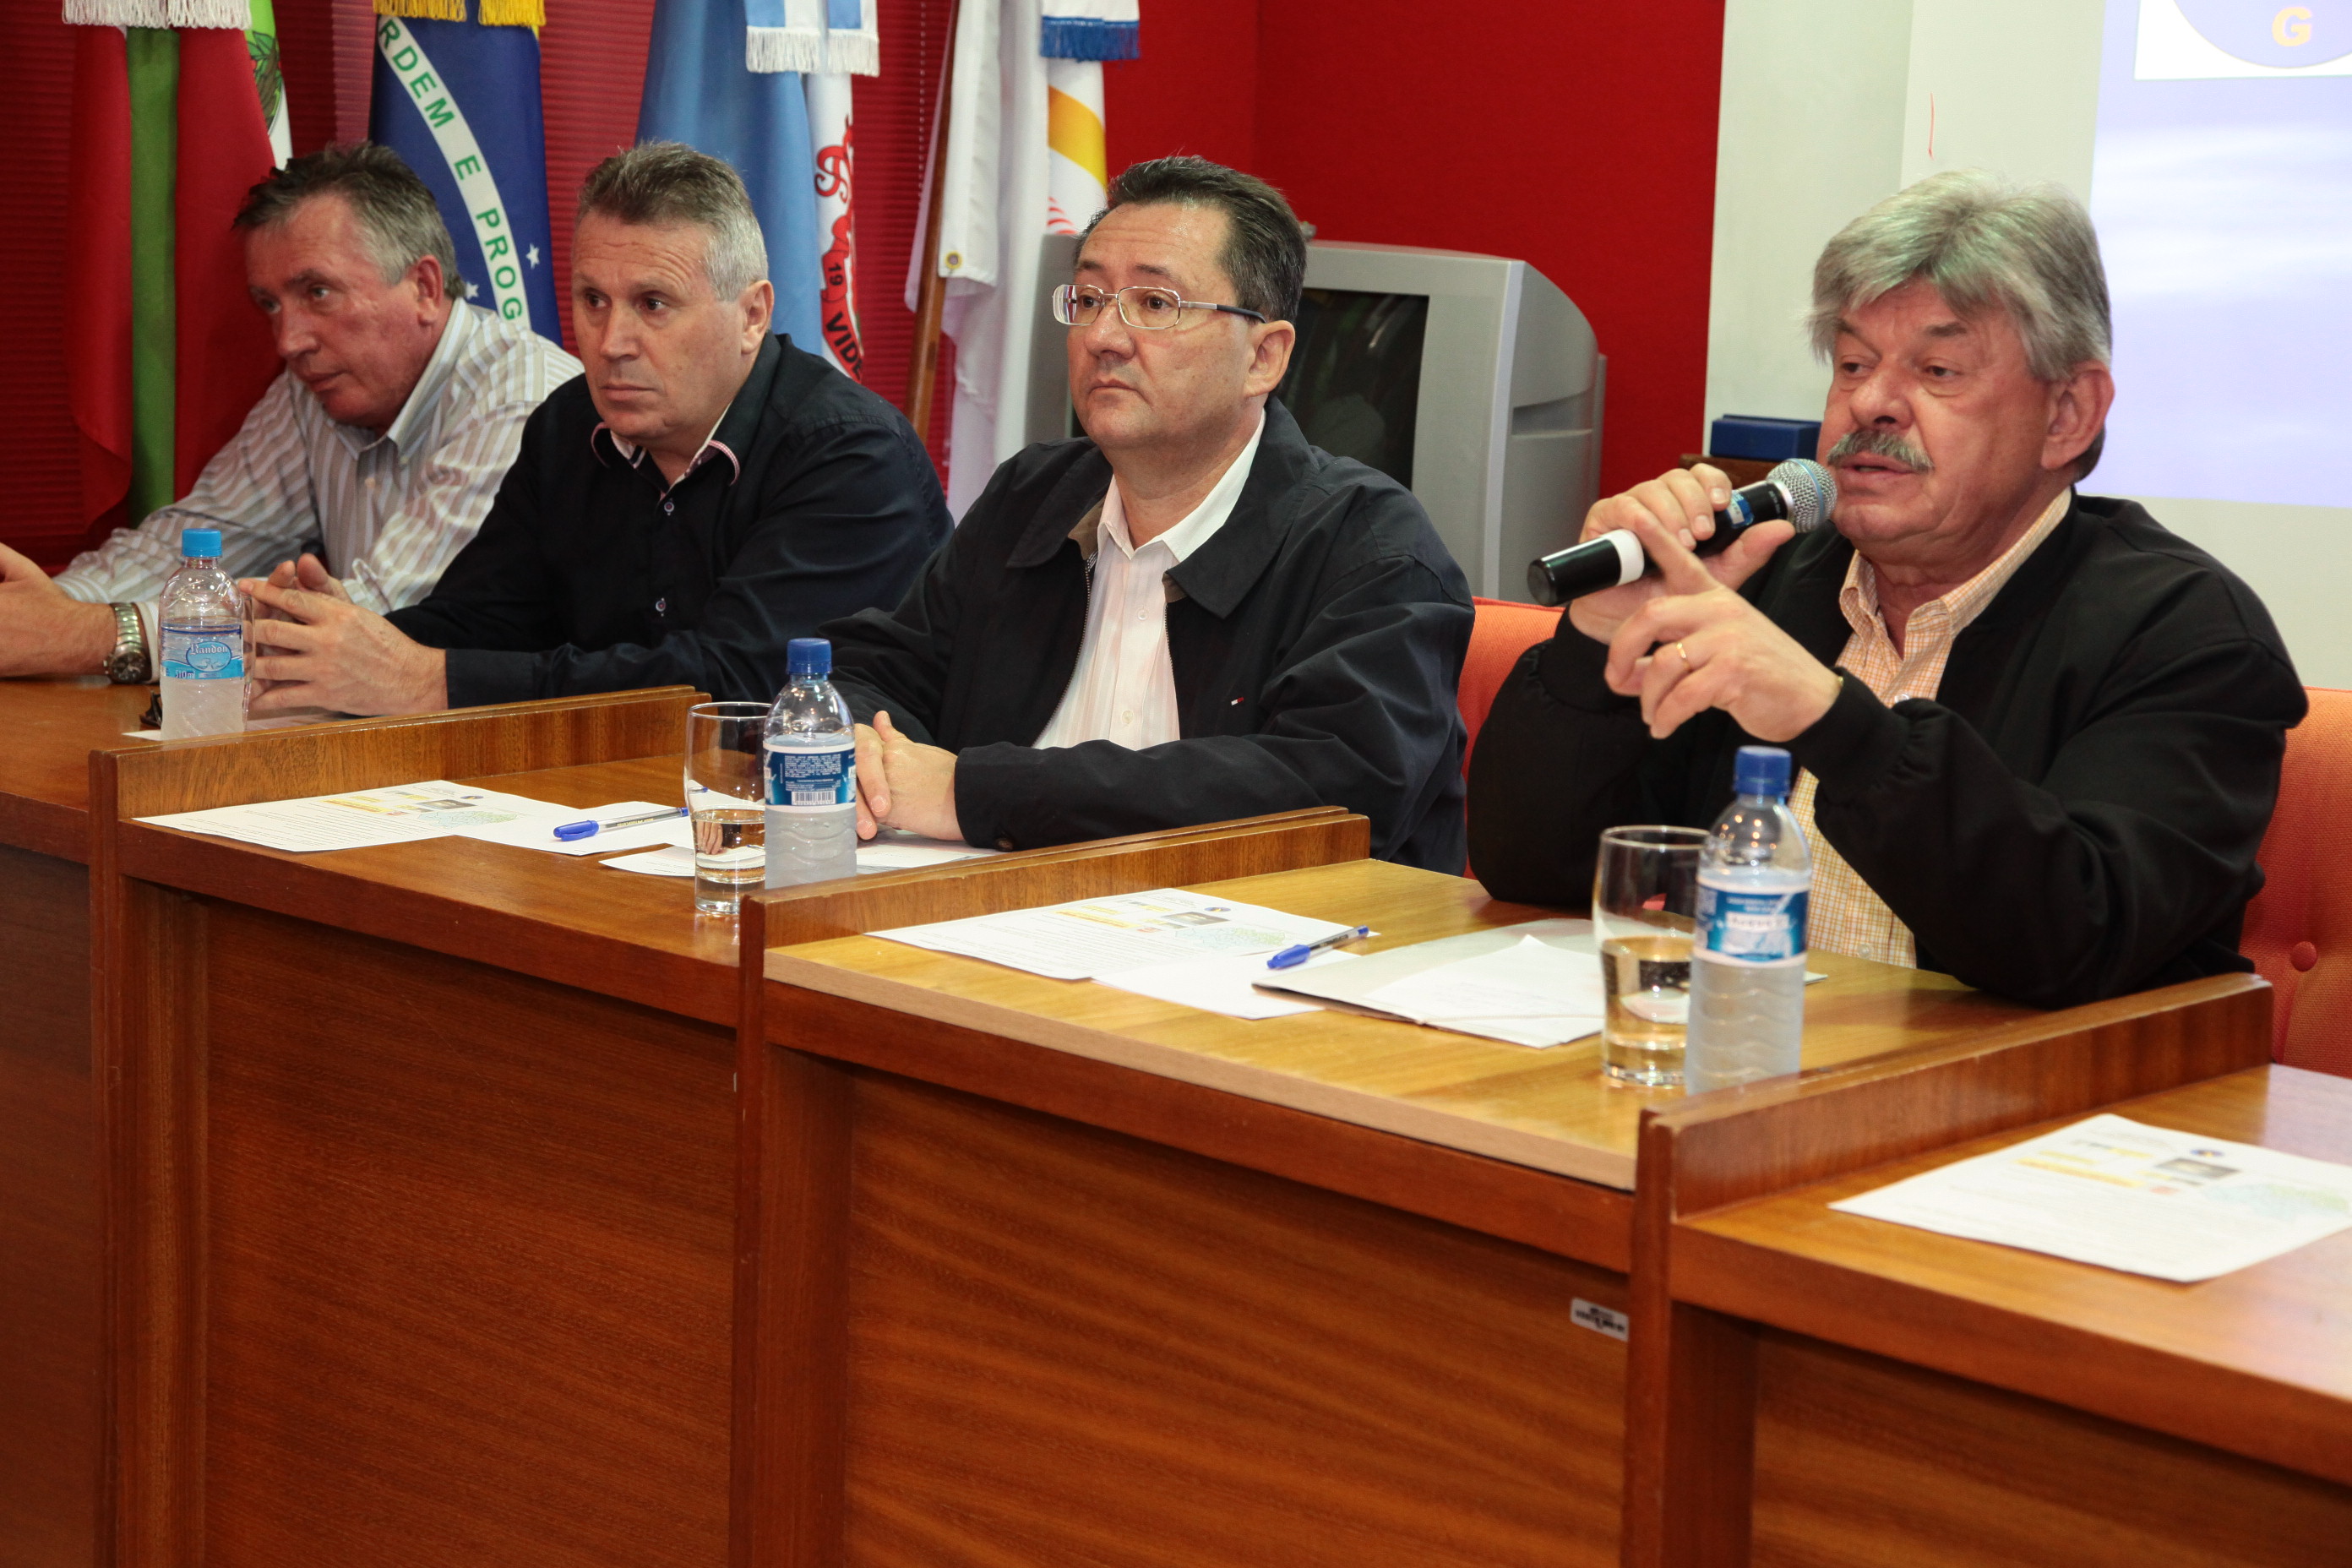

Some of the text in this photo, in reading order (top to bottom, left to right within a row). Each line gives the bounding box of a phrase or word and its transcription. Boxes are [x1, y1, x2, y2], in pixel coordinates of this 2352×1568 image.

[2271, 6, 2312, 47] G
[454, 155, 482, 181] E
[476, 208, 523, 321] PROG
[828, 262, 844, 286] 19
[190, 643, 228, 655] Randon
